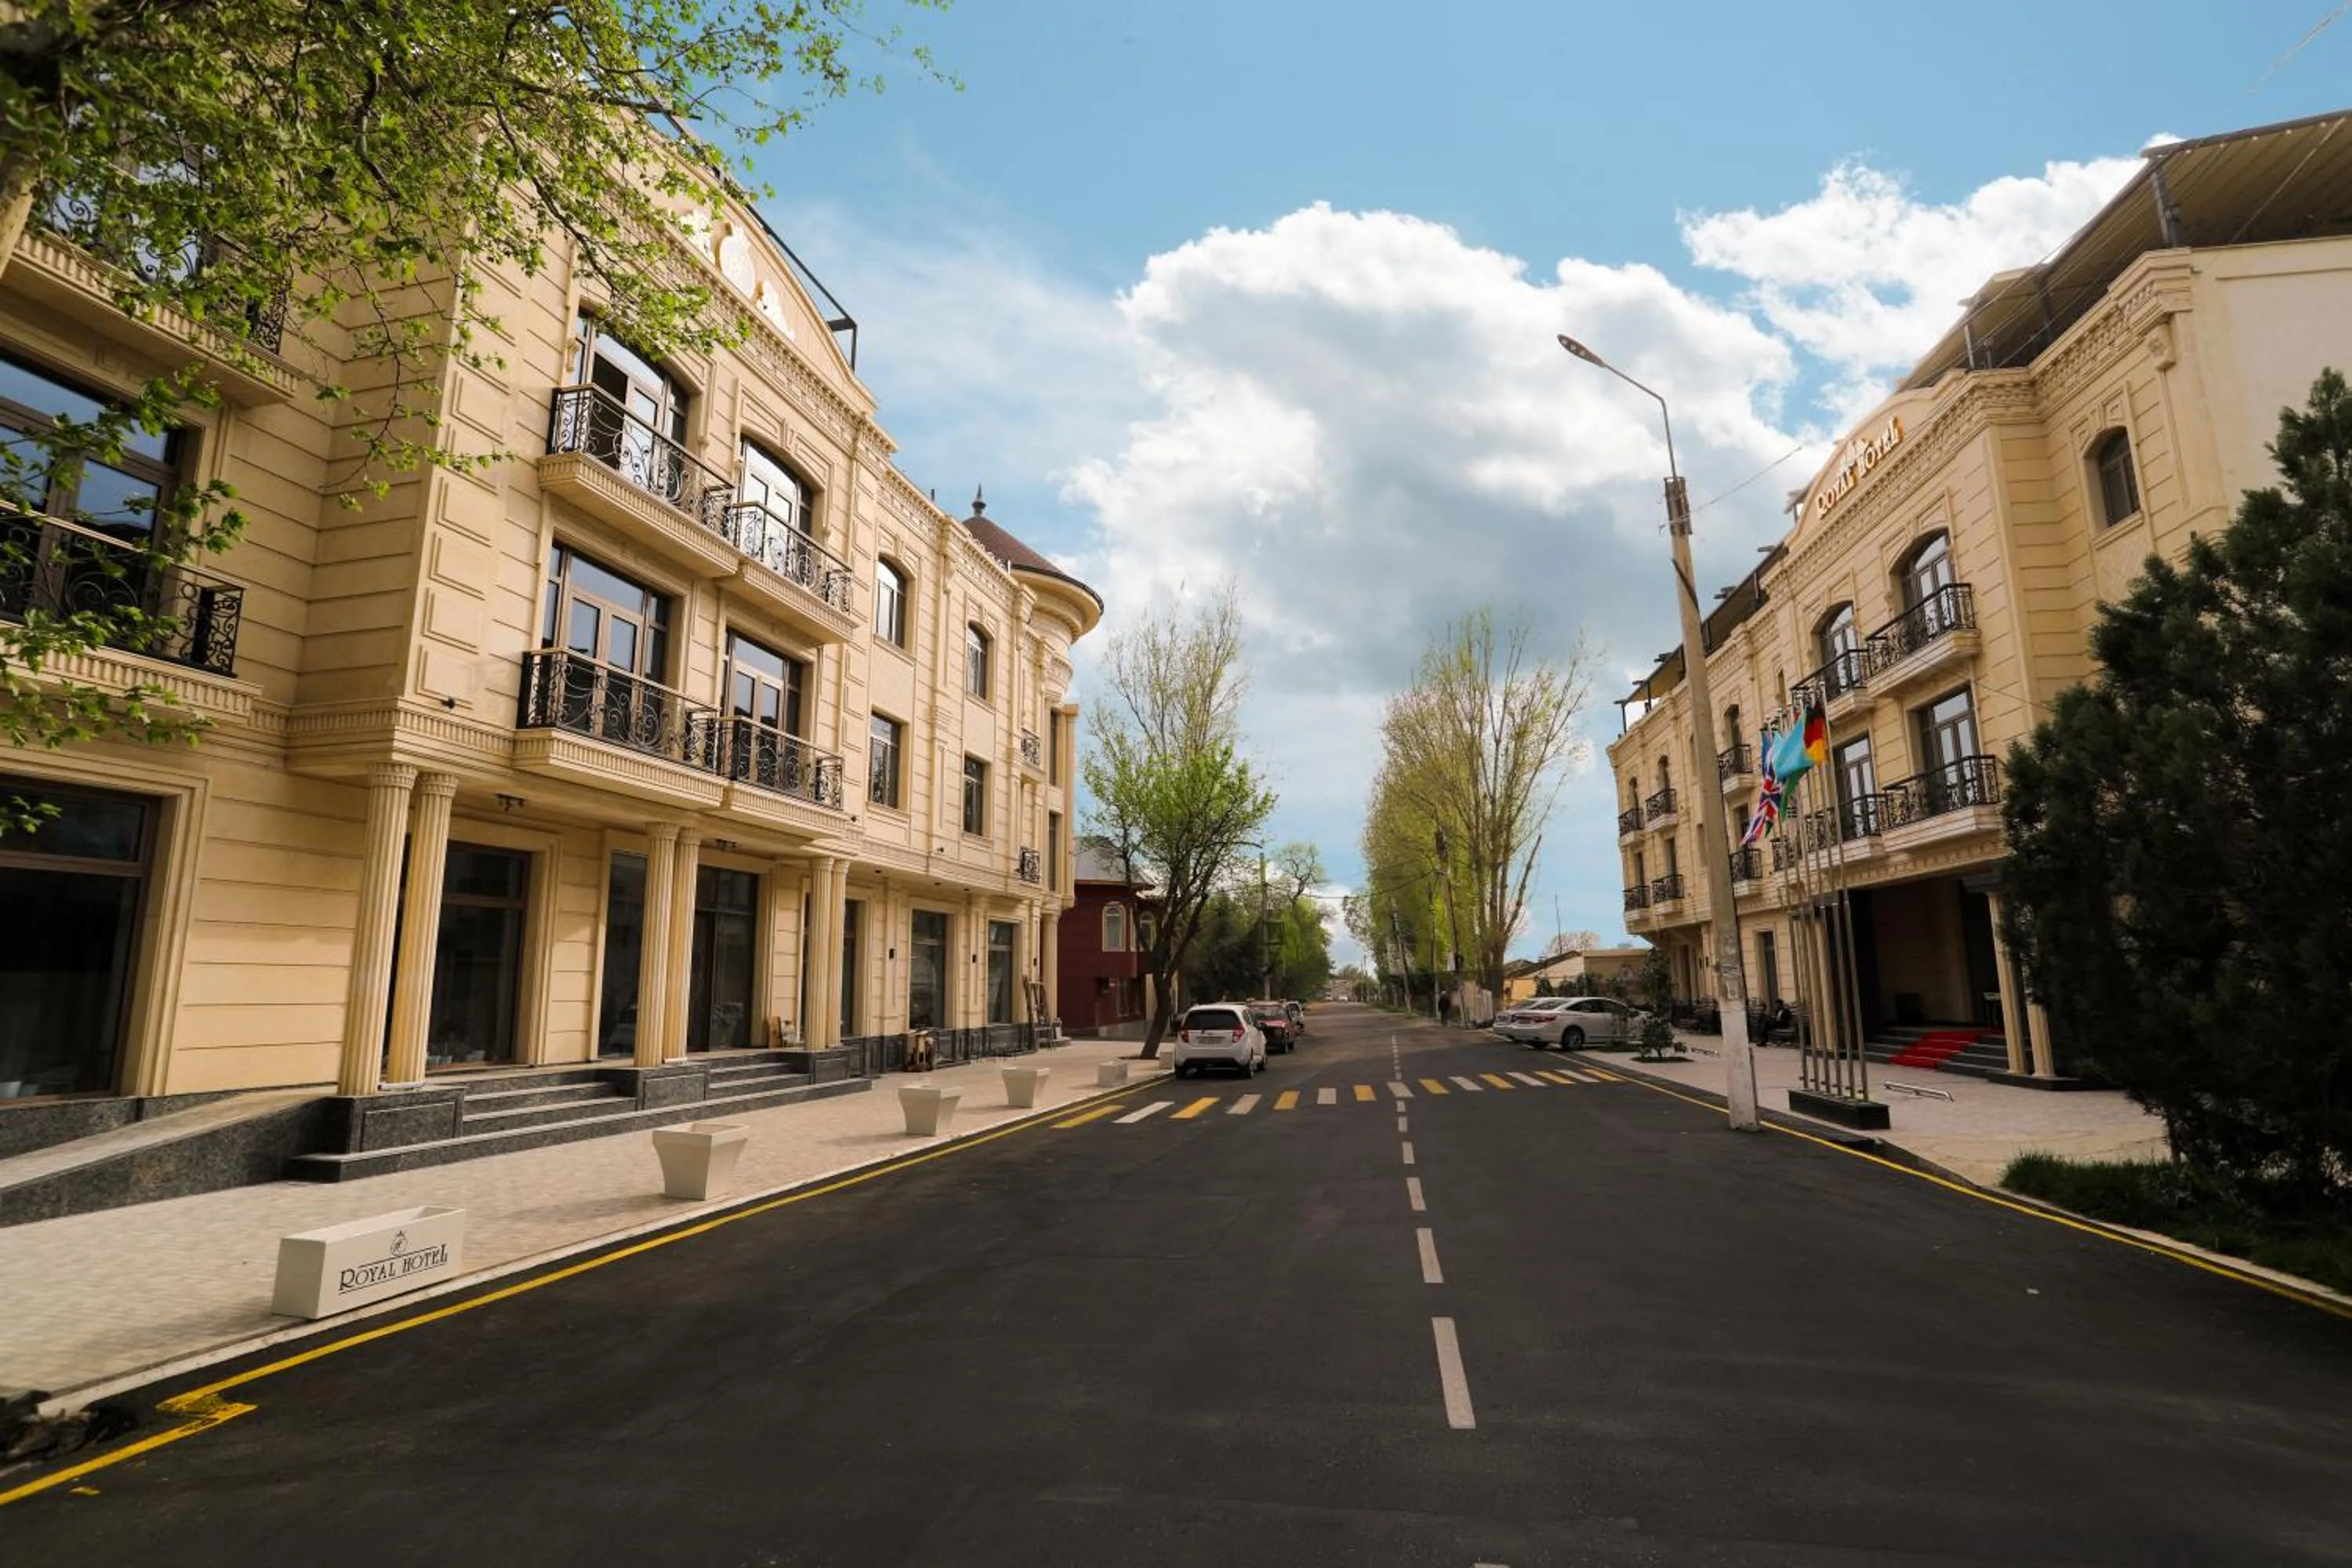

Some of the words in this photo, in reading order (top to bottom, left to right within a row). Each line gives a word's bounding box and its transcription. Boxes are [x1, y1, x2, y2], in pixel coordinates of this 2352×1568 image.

[1857, 416, 1903, 478] HOTEL
[339, 1261, 396, 1291] ROYAL
[402, 1243, 448, 1274] HOTEL
